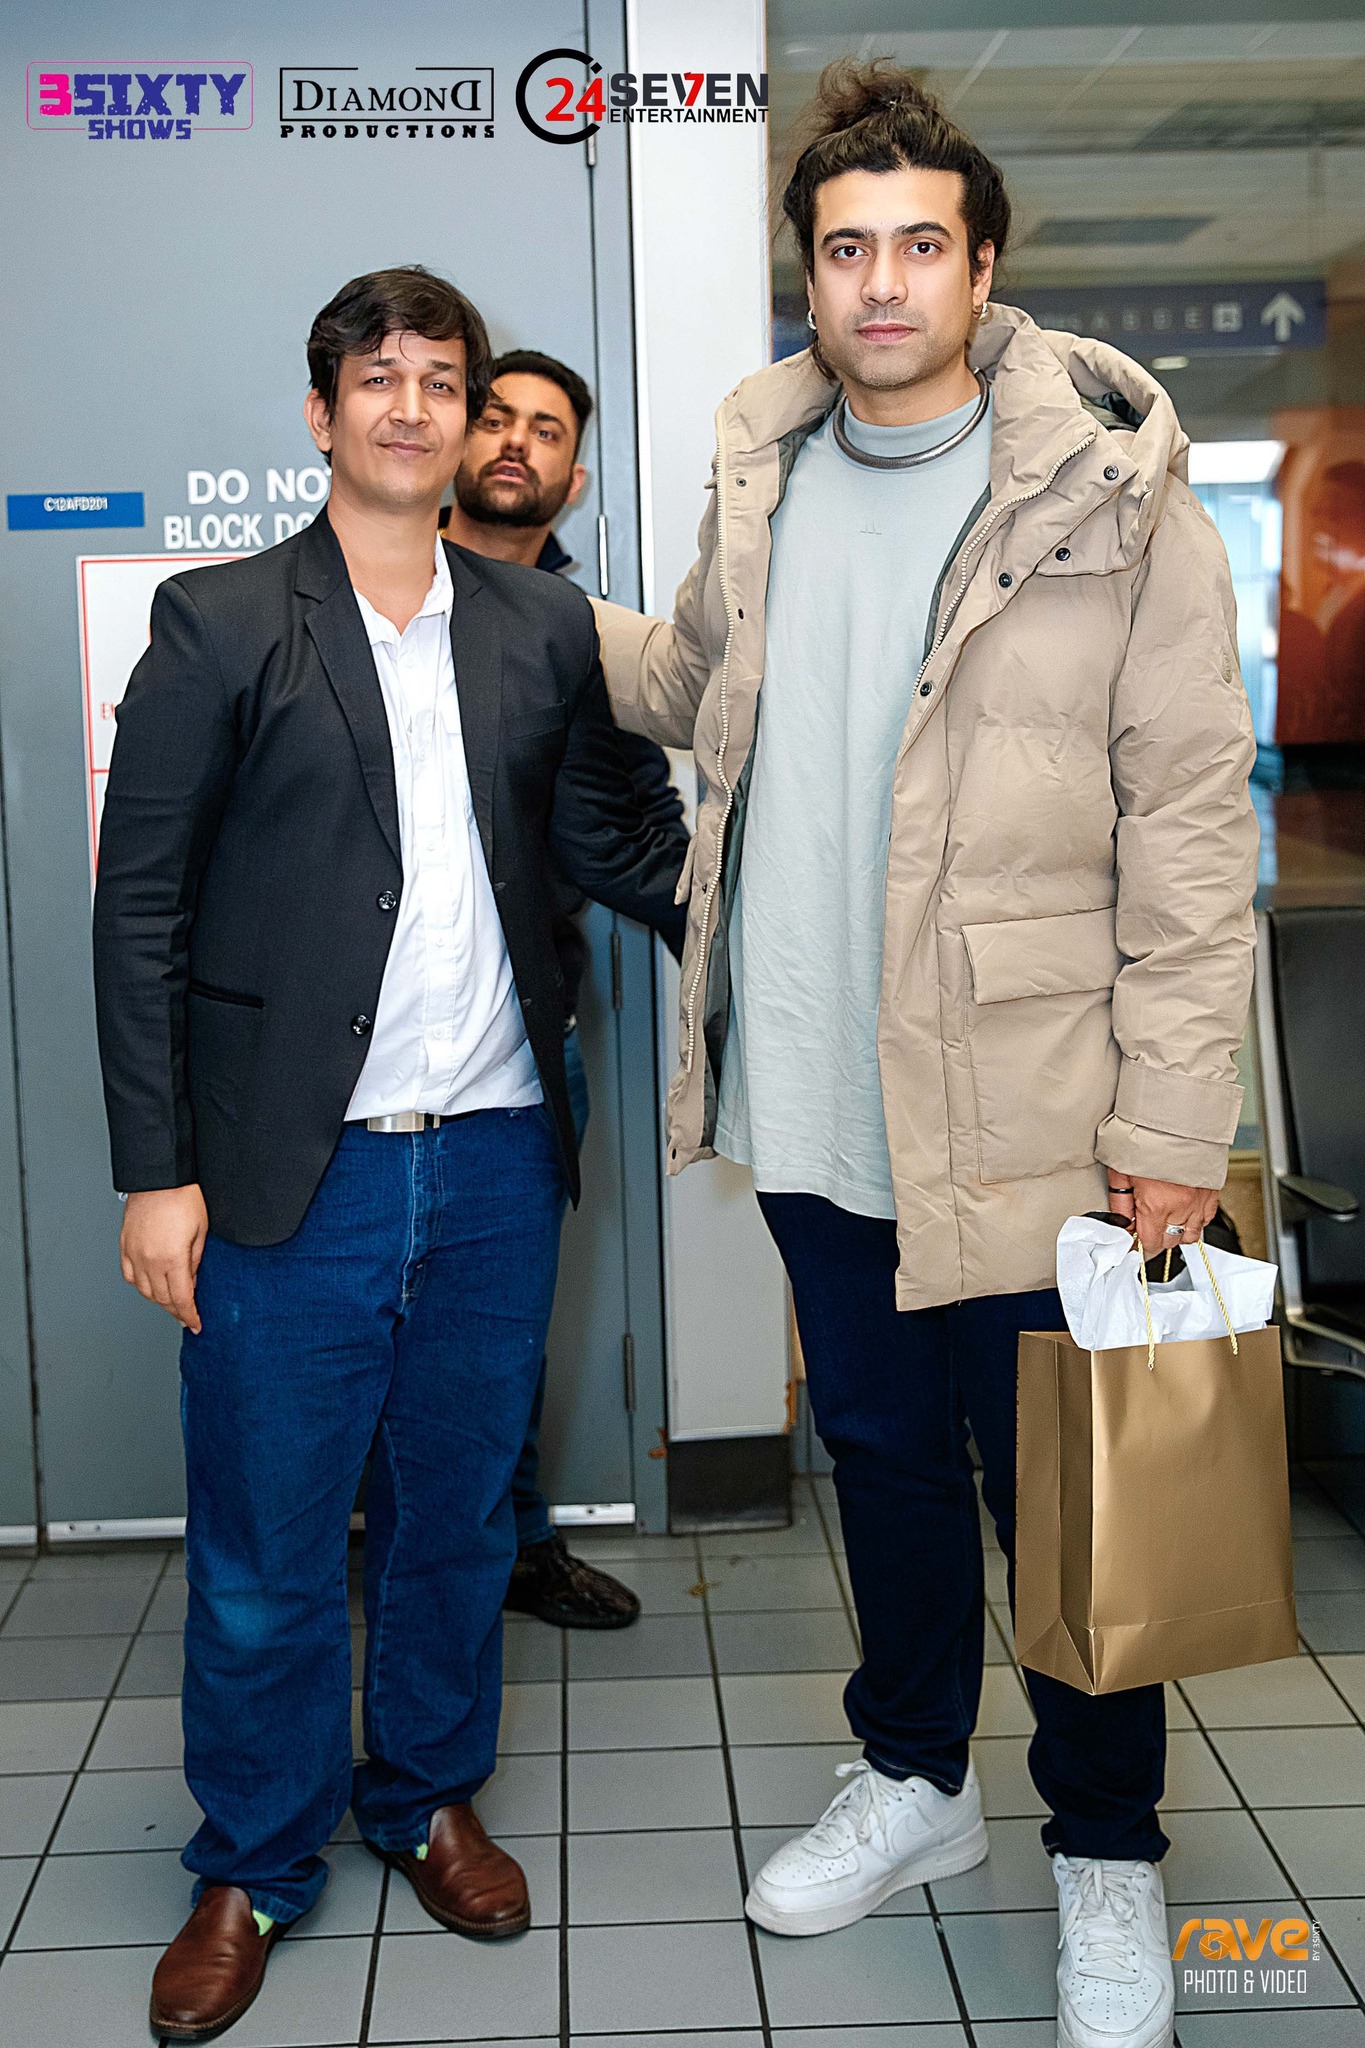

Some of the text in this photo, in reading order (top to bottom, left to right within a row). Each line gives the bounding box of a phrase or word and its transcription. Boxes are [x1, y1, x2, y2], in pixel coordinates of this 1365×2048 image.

[187, 465, 332, 505] DO NO
[163, 513, 265, 550] BLOCK
